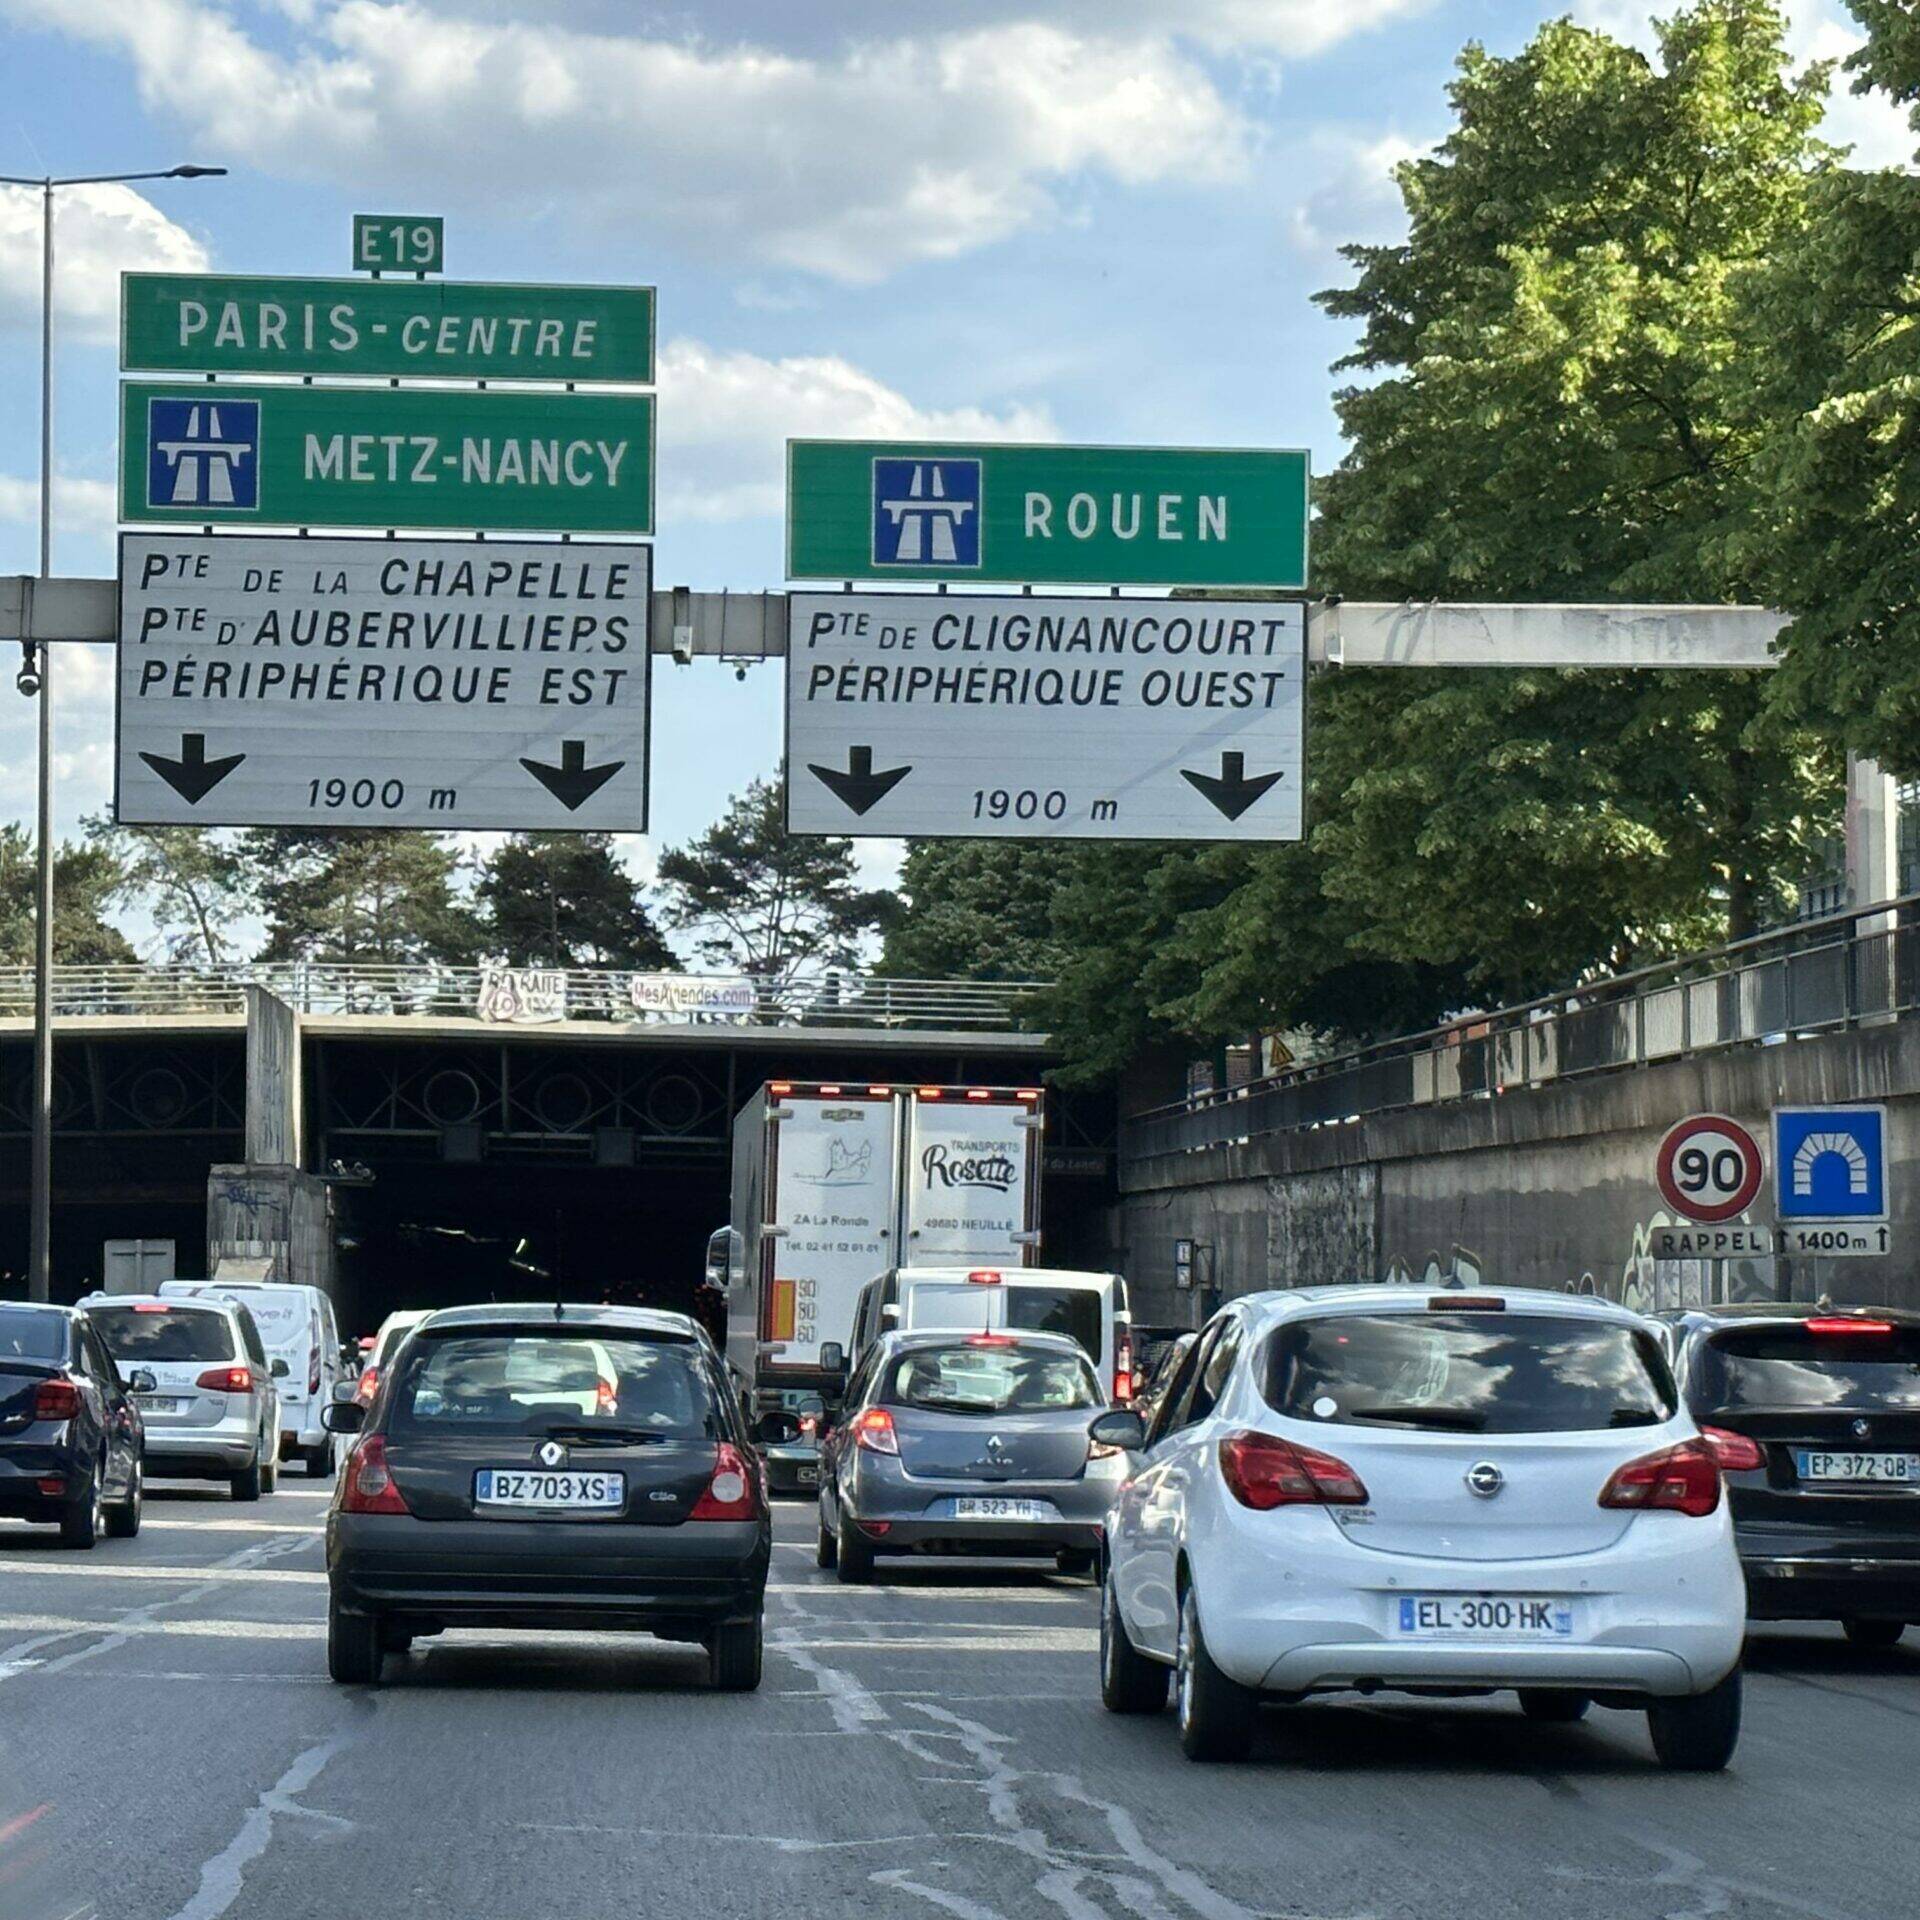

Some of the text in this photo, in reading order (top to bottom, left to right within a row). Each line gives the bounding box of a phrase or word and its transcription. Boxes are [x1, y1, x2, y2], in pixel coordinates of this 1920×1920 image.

[361, 224, 436, 264] E19
[304, 433, 628, 488] METZ-NANCY
[1025, 491, 1227, 542] ROUEN
[243, 569, 282, 594] DE
[313, 570, 348, 596] LA
[380, 559, 630, 600] CHAPELLE
[879, 626, 916, 650] DE
[932, 614, 1285, 656] CLIGNANCOURT
[139, 653, 627, 706] PÉRIPHÉRIQUE EST
[807, 658, 1285, 709] PÉRIPHÉRIQUE OUEST
[309, 779, 457, 811] 1900 m
[973, 790, 1118, 821] 1900 m
[950, 1140, 1020, 1153] TRANSPORTS
[922, 1144, 1018, 1190] Rosette
[1679, 1148, 1743, 1193] 90
[793, 1214, 869, 1227] ZA La Ronde
[1661, 1231, 1762, 1252] RAPPEL
[496, 1476, 605, 1500] BZ-703-XS
[1418, 1602, 1553, 1629] EL-300-HK
